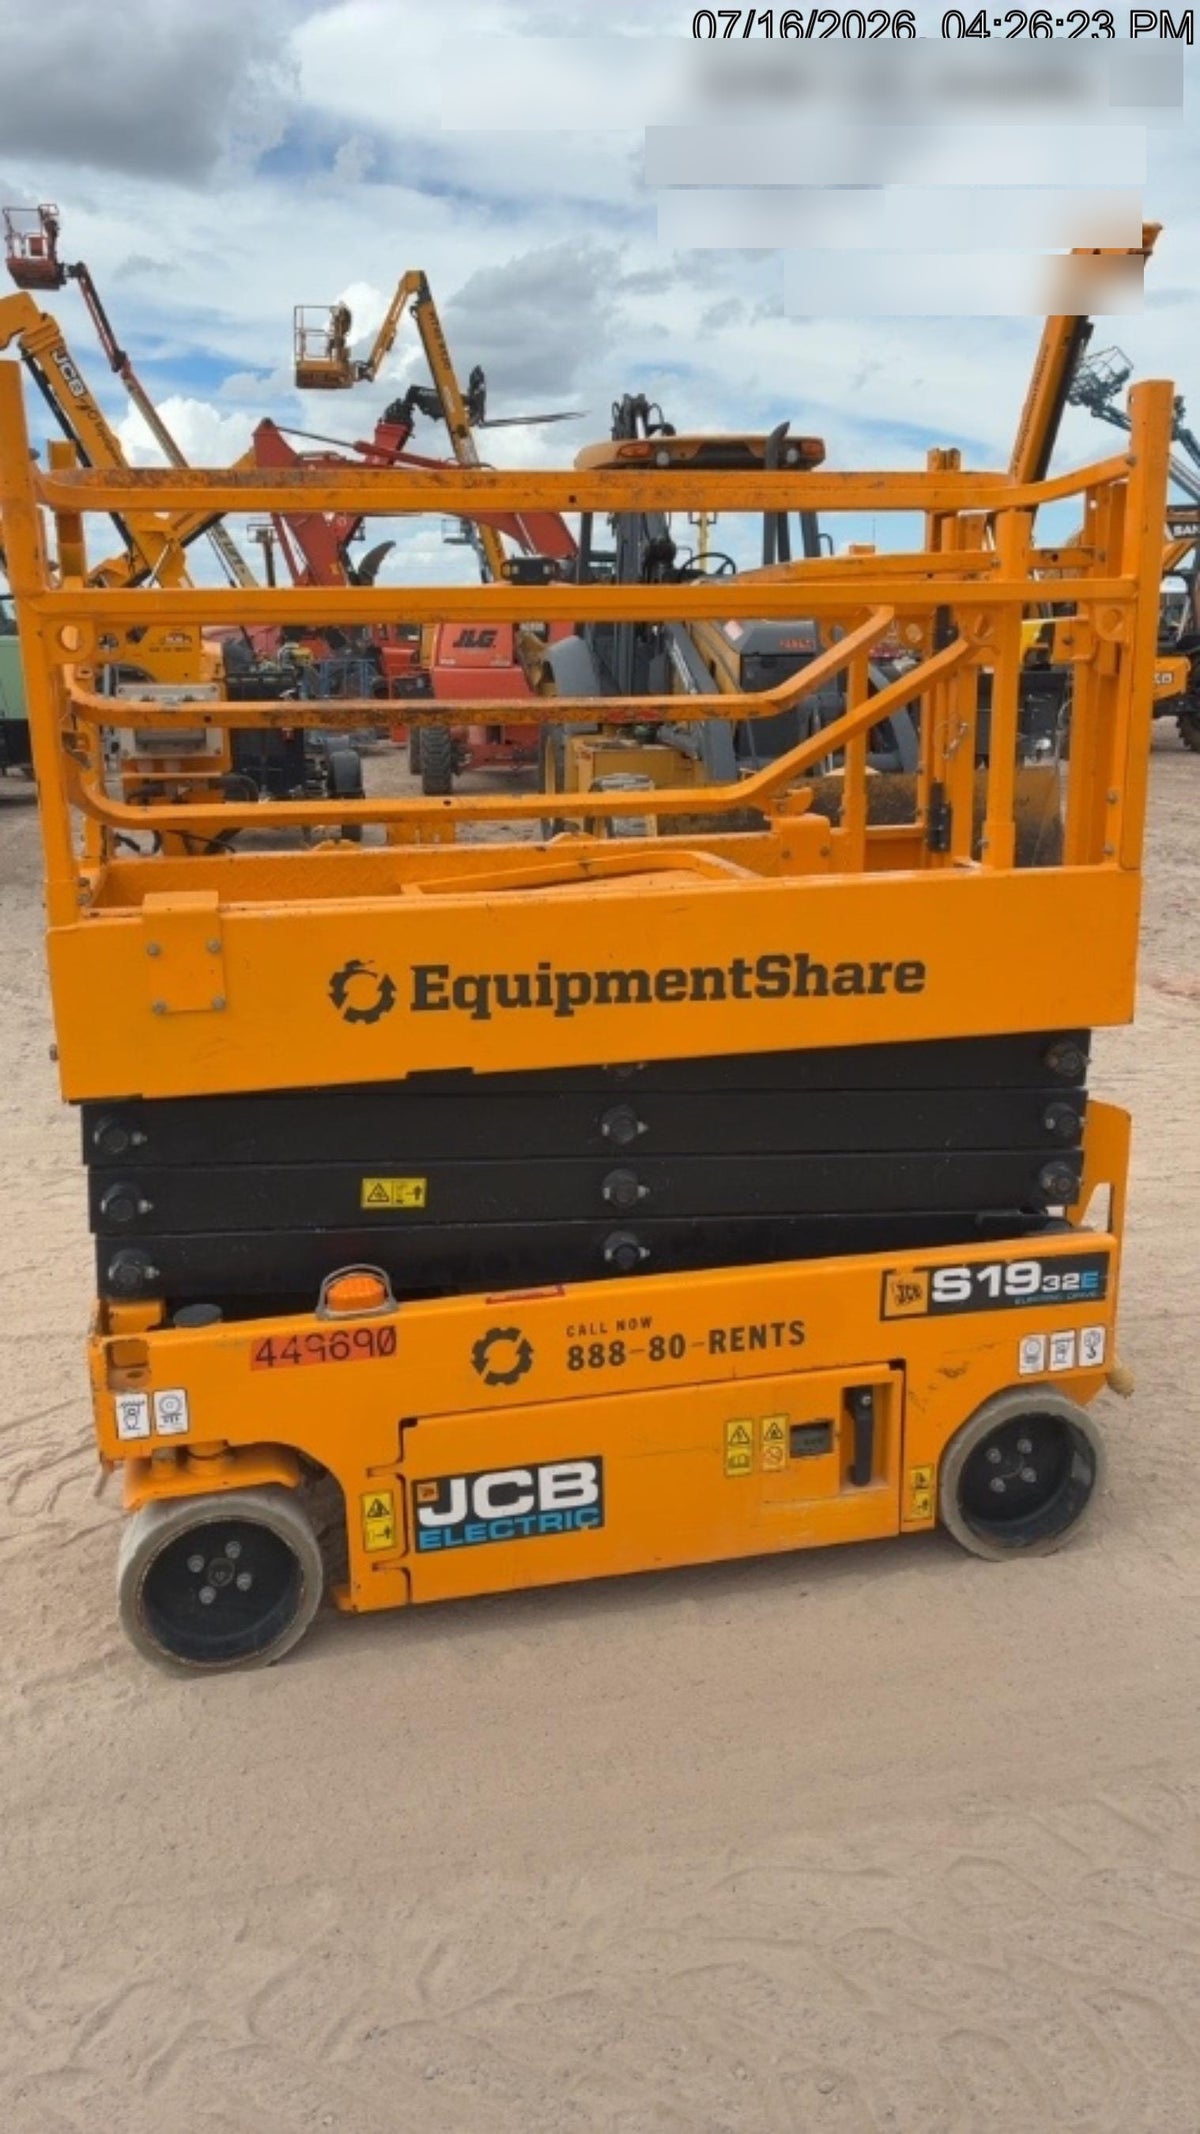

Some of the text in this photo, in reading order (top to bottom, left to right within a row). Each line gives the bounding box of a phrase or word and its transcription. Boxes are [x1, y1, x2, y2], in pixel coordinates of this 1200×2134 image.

[50, 347, 87, 397] JCB
[1173, 523, 1200, 537] SAN
[410, 952, 926, 1020] EquipmentShare
[255, 1325, 397, 1367] 449690
[566, 1315, 654, 1338] CALL NOW
[417, 1461, 600, 1528] JCB
[418, 1507, 600, 1550] ELECTRIC
